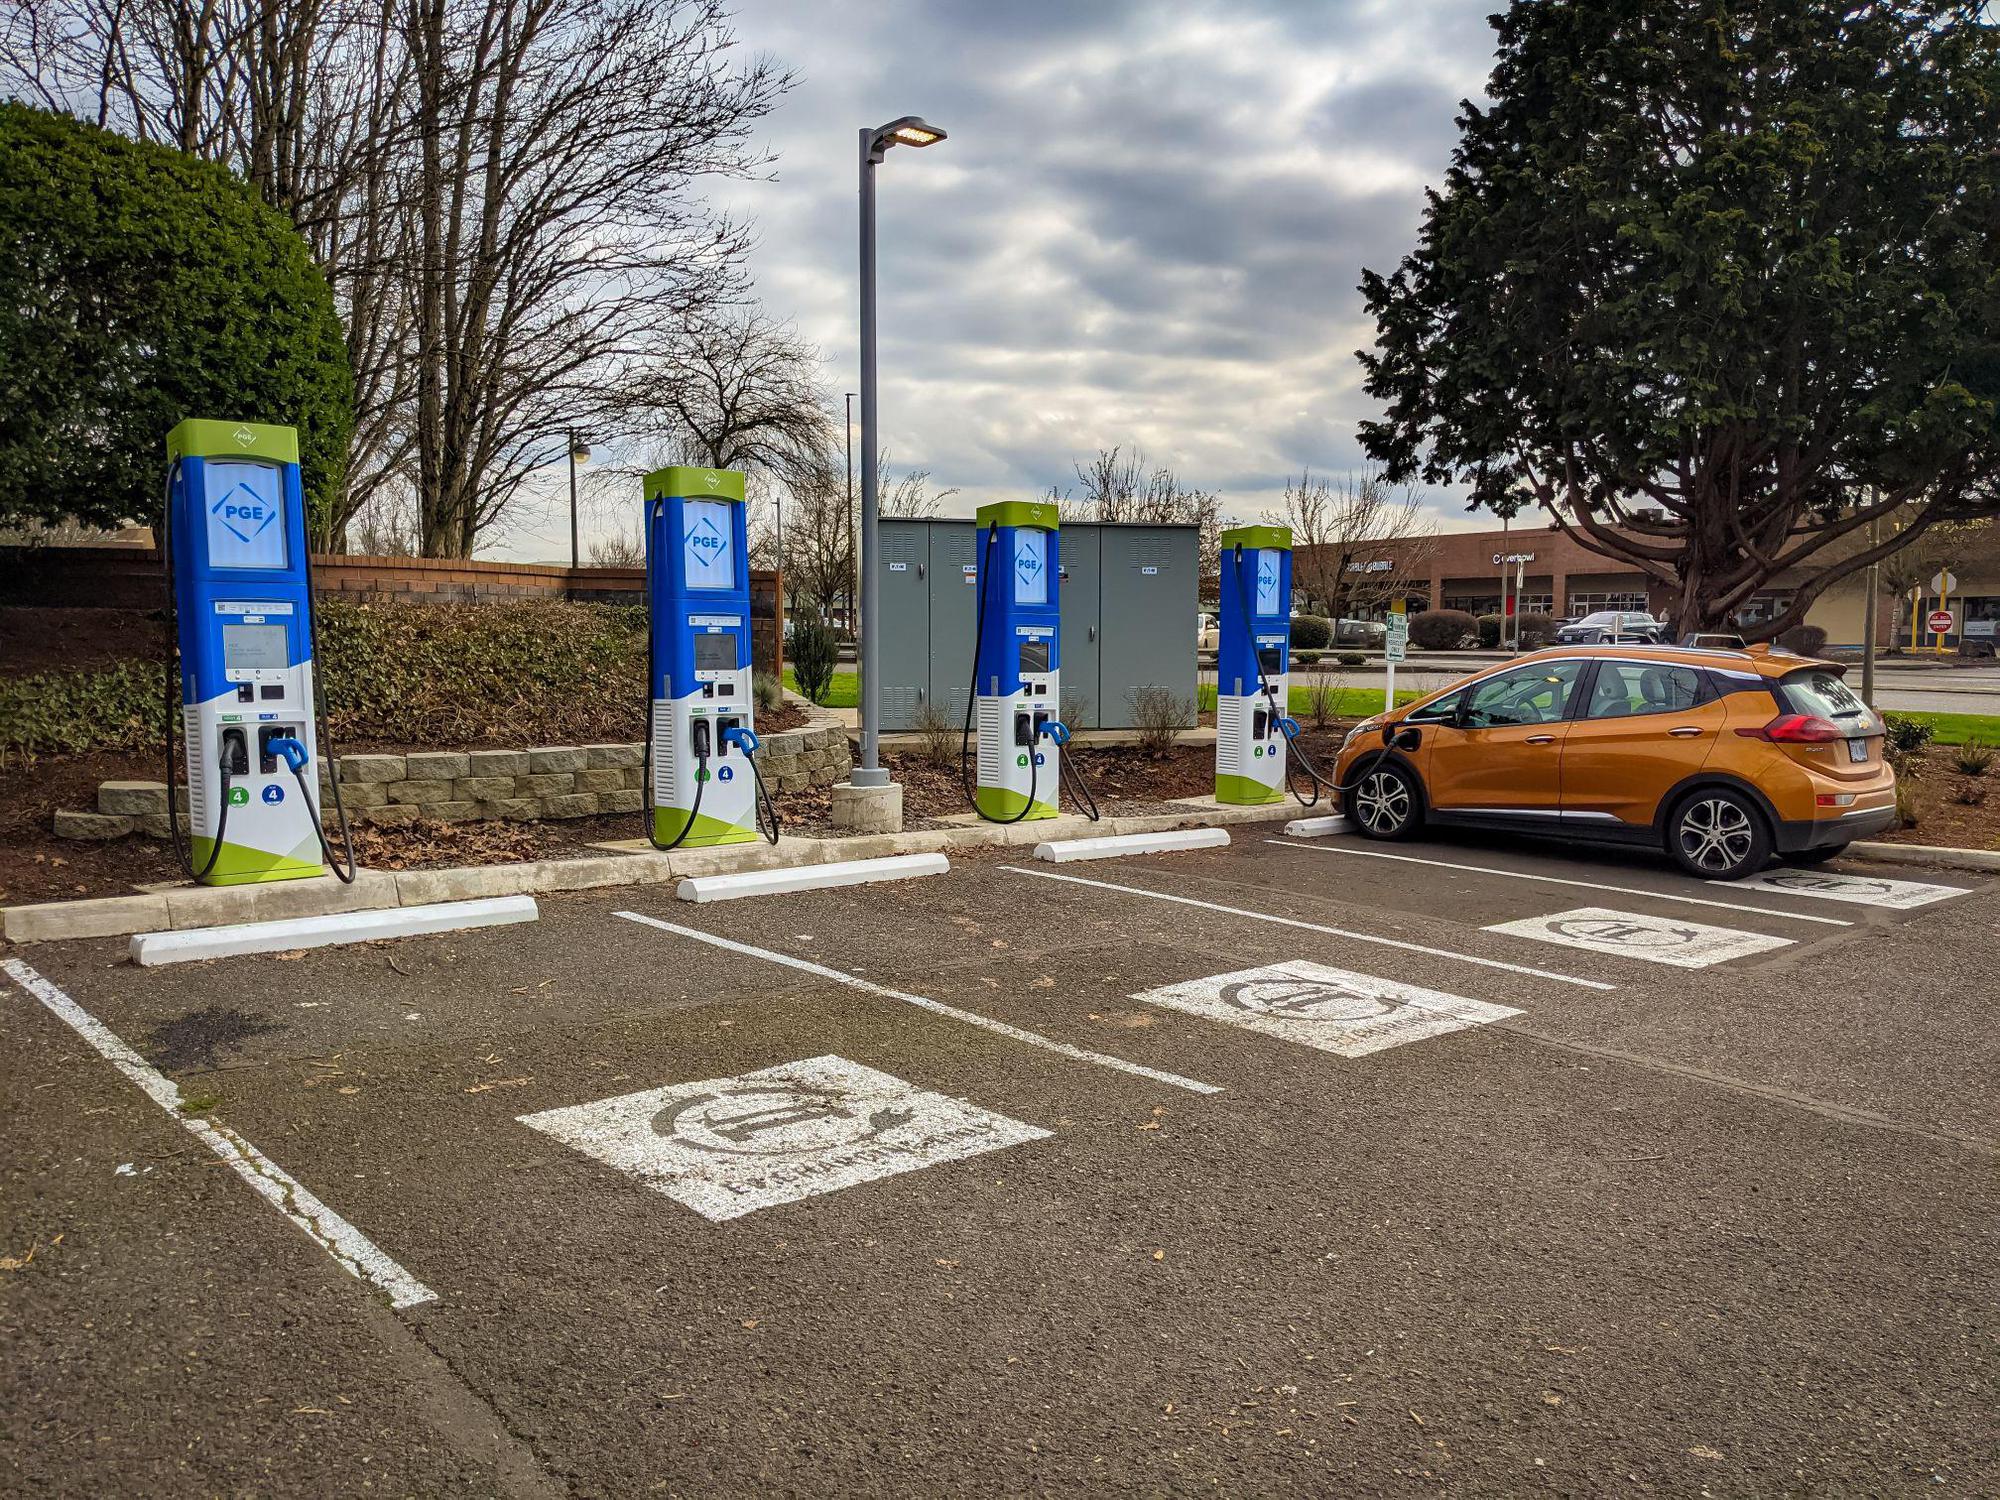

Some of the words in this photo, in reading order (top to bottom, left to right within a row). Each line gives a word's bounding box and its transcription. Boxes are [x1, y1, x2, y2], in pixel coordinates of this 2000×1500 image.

[237, 433, 252, 441] PGE
[225, 505, 263, 520] PGE
[693, 536, 718, 548] PGE
[1018, 559, 1037, 570] PGE
[1258, 576, 1272, 585] PGE
[1388, 616, 1393, 629] 2
[1020, 756, 1026, 765] 4
[722, 770, 729, 779] 4
[234, 791, 242, 801] 4
[269, 789, 277, 799] 4
